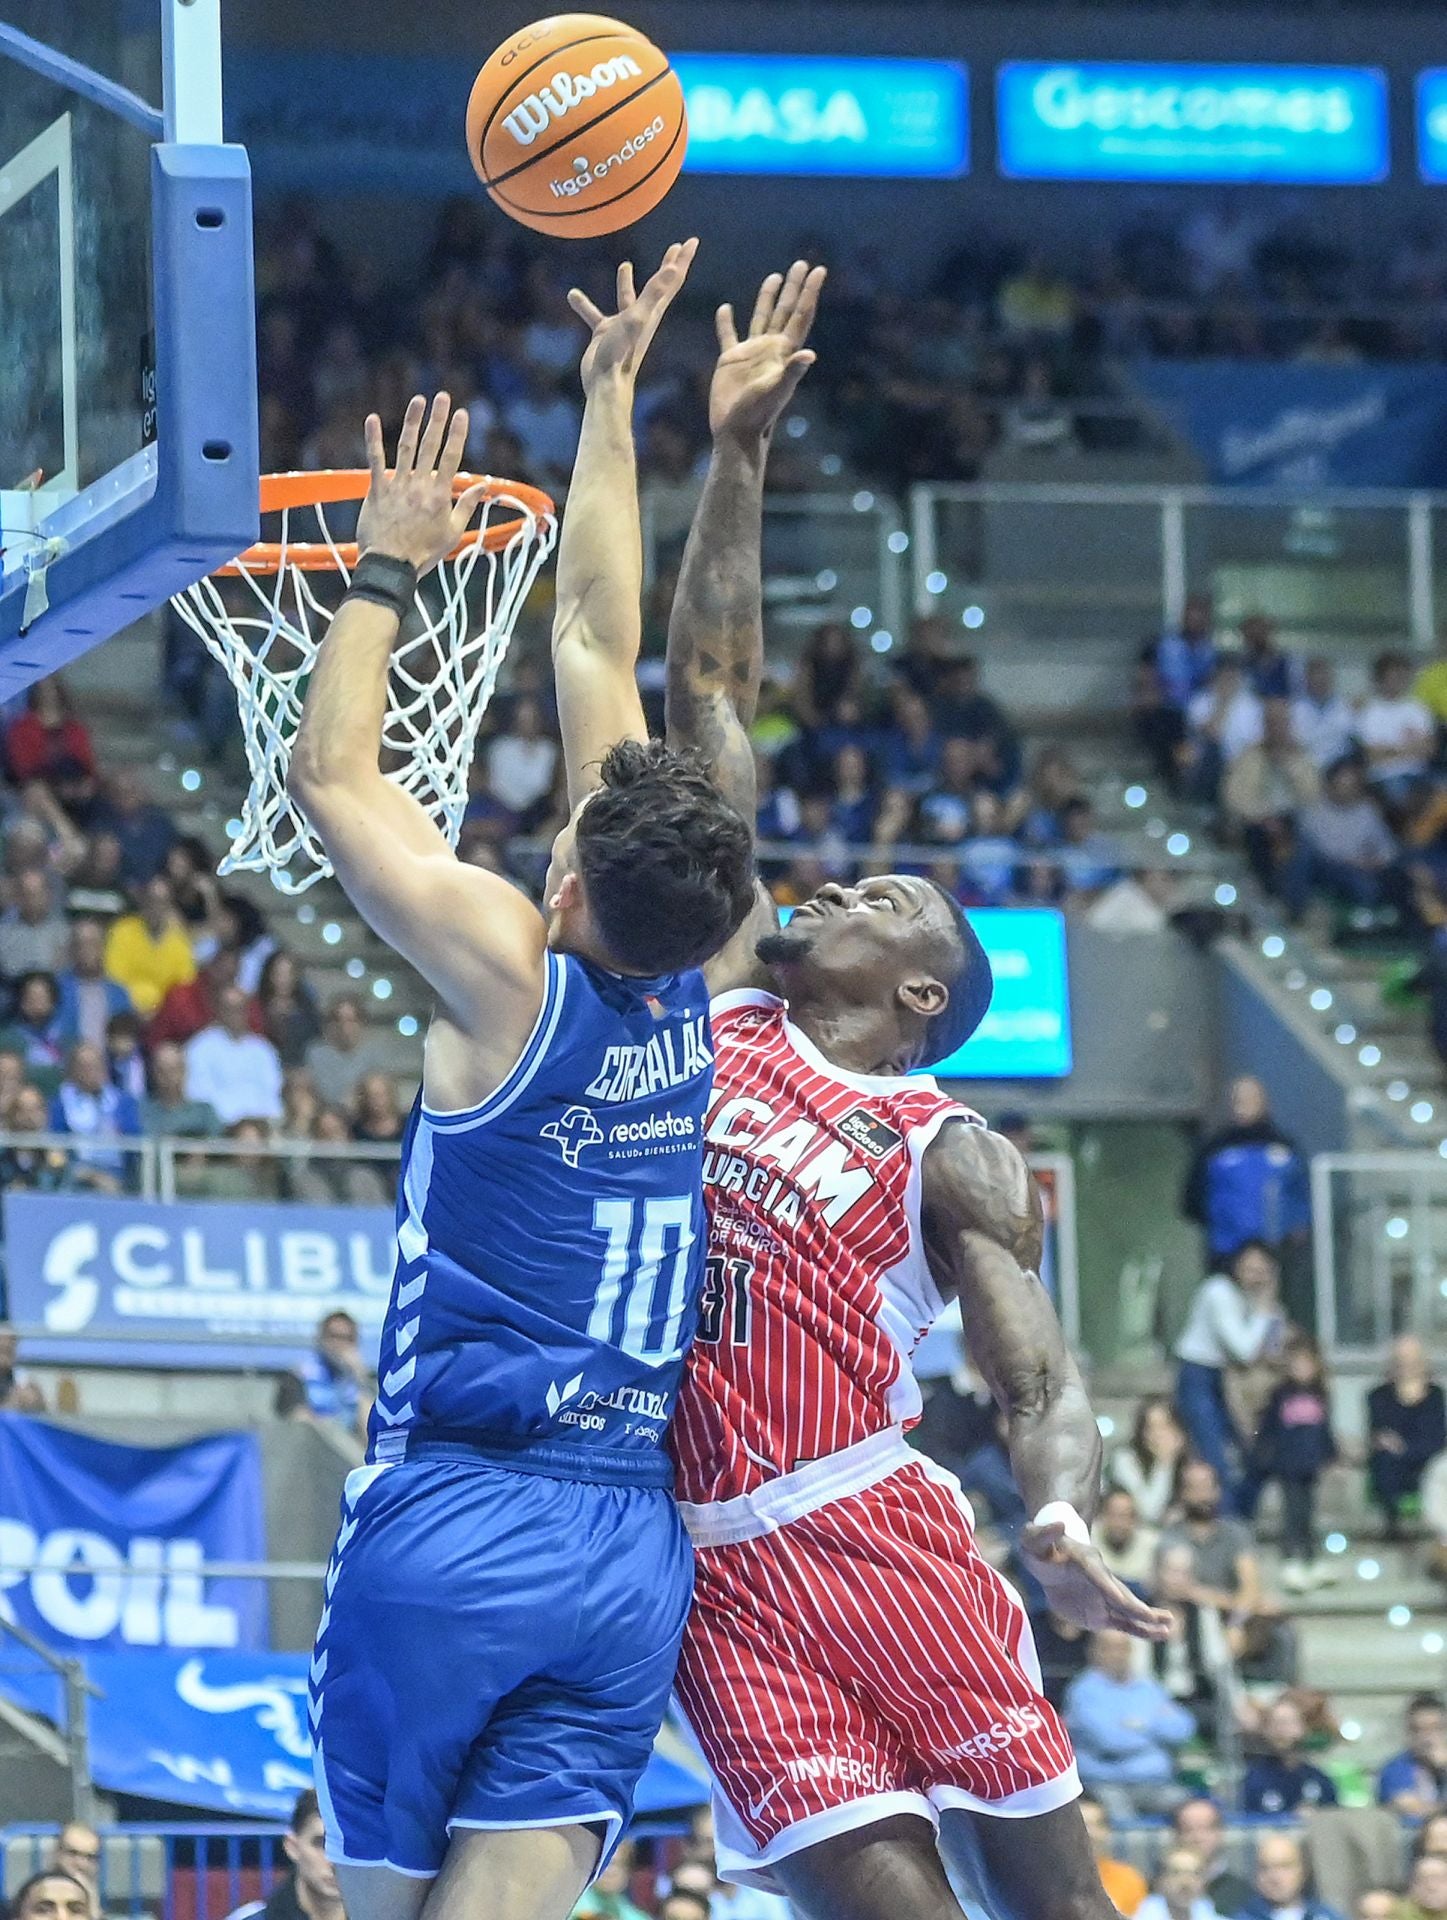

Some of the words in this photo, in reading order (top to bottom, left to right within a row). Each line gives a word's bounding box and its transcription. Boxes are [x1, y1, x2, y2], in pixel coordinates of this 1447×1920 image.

[501, 54, 643, 145] Wilson
[686, 84, 869, 144] BASA
[549, 169, 593, 198] liga
[593, 115, 665, 178] endesa
[142, 366, 156, 402] lig
[609, 1111, 695, 1144] recoletas
[841, 1122, 885, 1155] endesa
[701, 1150, 801, 1228] URCIA
[110, 1222, 398, 1297] CLIBU
[585, 1193, 697, 1367] 10
[700, 1256, 755, 1346] 31
[788, 1755, 895, 1793] INVERSUS
